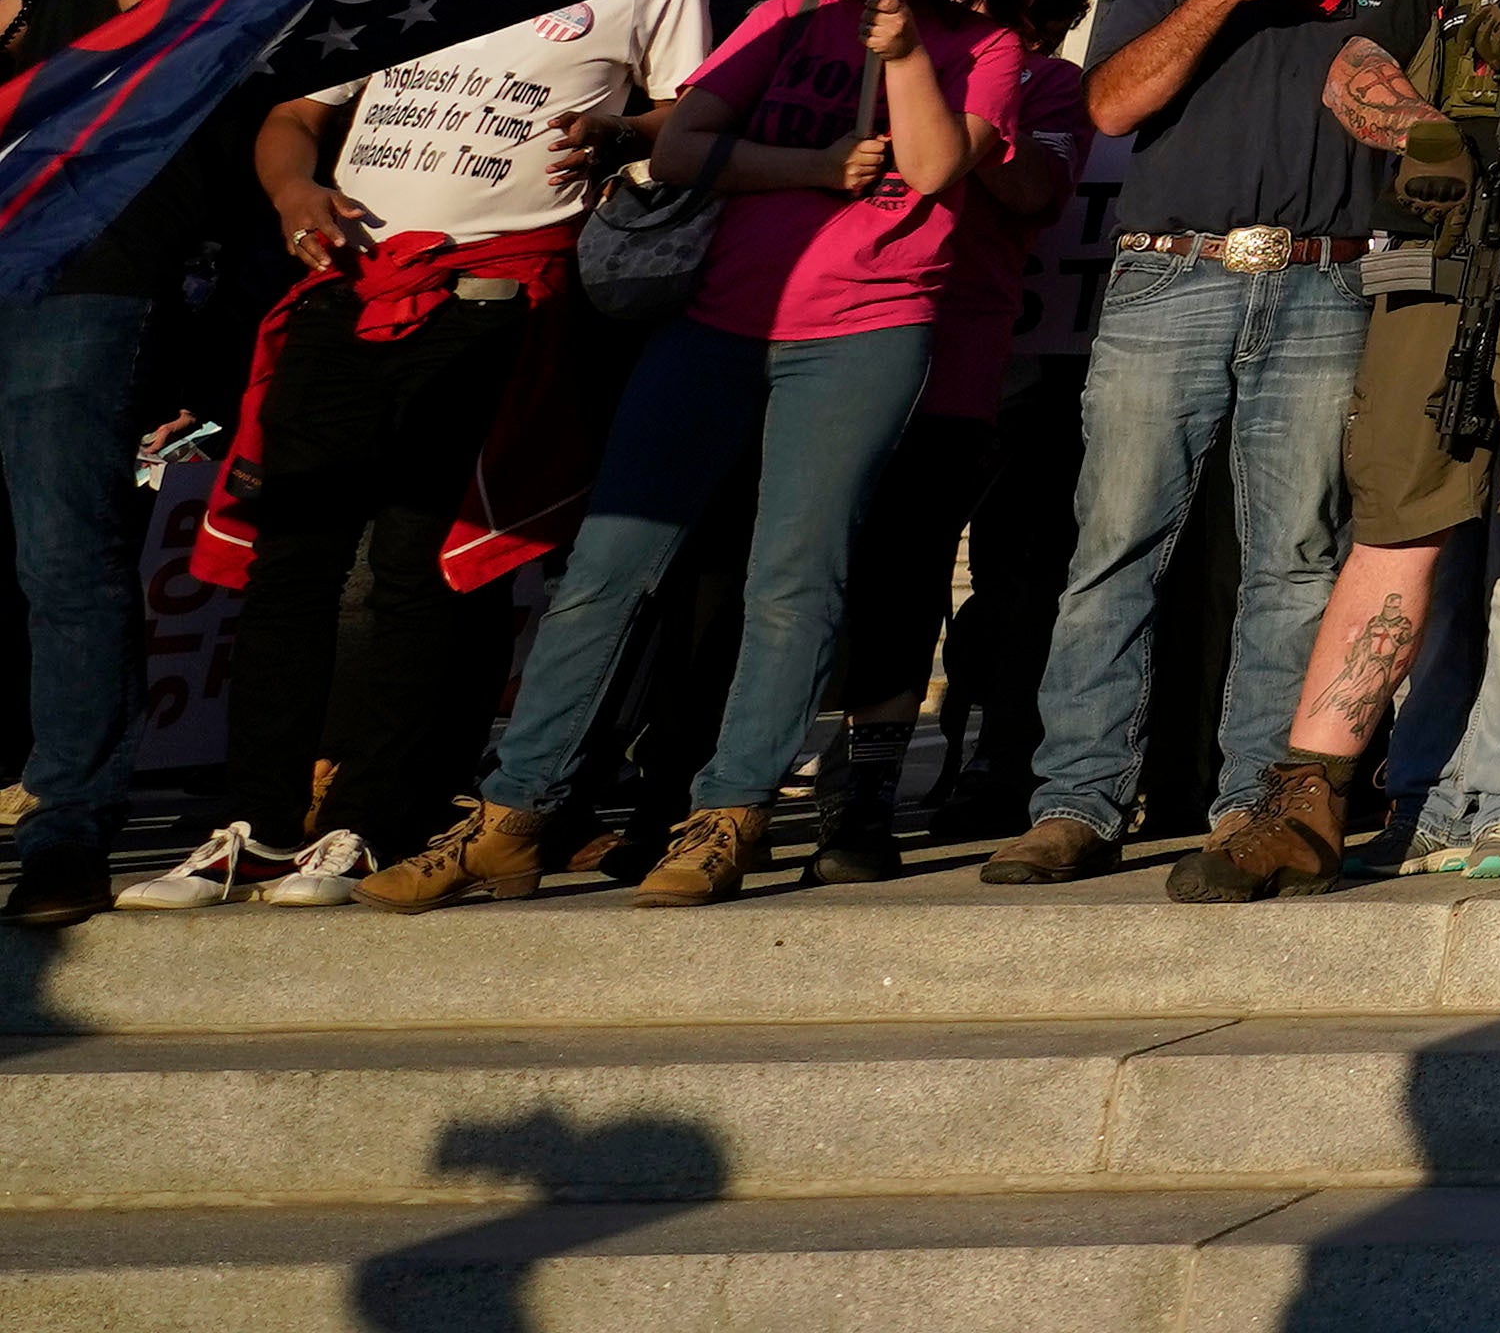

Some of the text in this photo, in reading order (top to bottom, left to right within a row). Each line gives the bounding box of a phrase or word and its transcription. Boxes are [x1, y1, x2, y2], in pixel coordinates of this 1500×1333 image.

[460, 68, 493, 98] for
[494, 72, 551, 113] Trump
[437, 103, 470, 131] for
[475, 106, 534, 147] Trump
[413, 142, 447, 172] for
[451, 145, 513, 187] Trump
